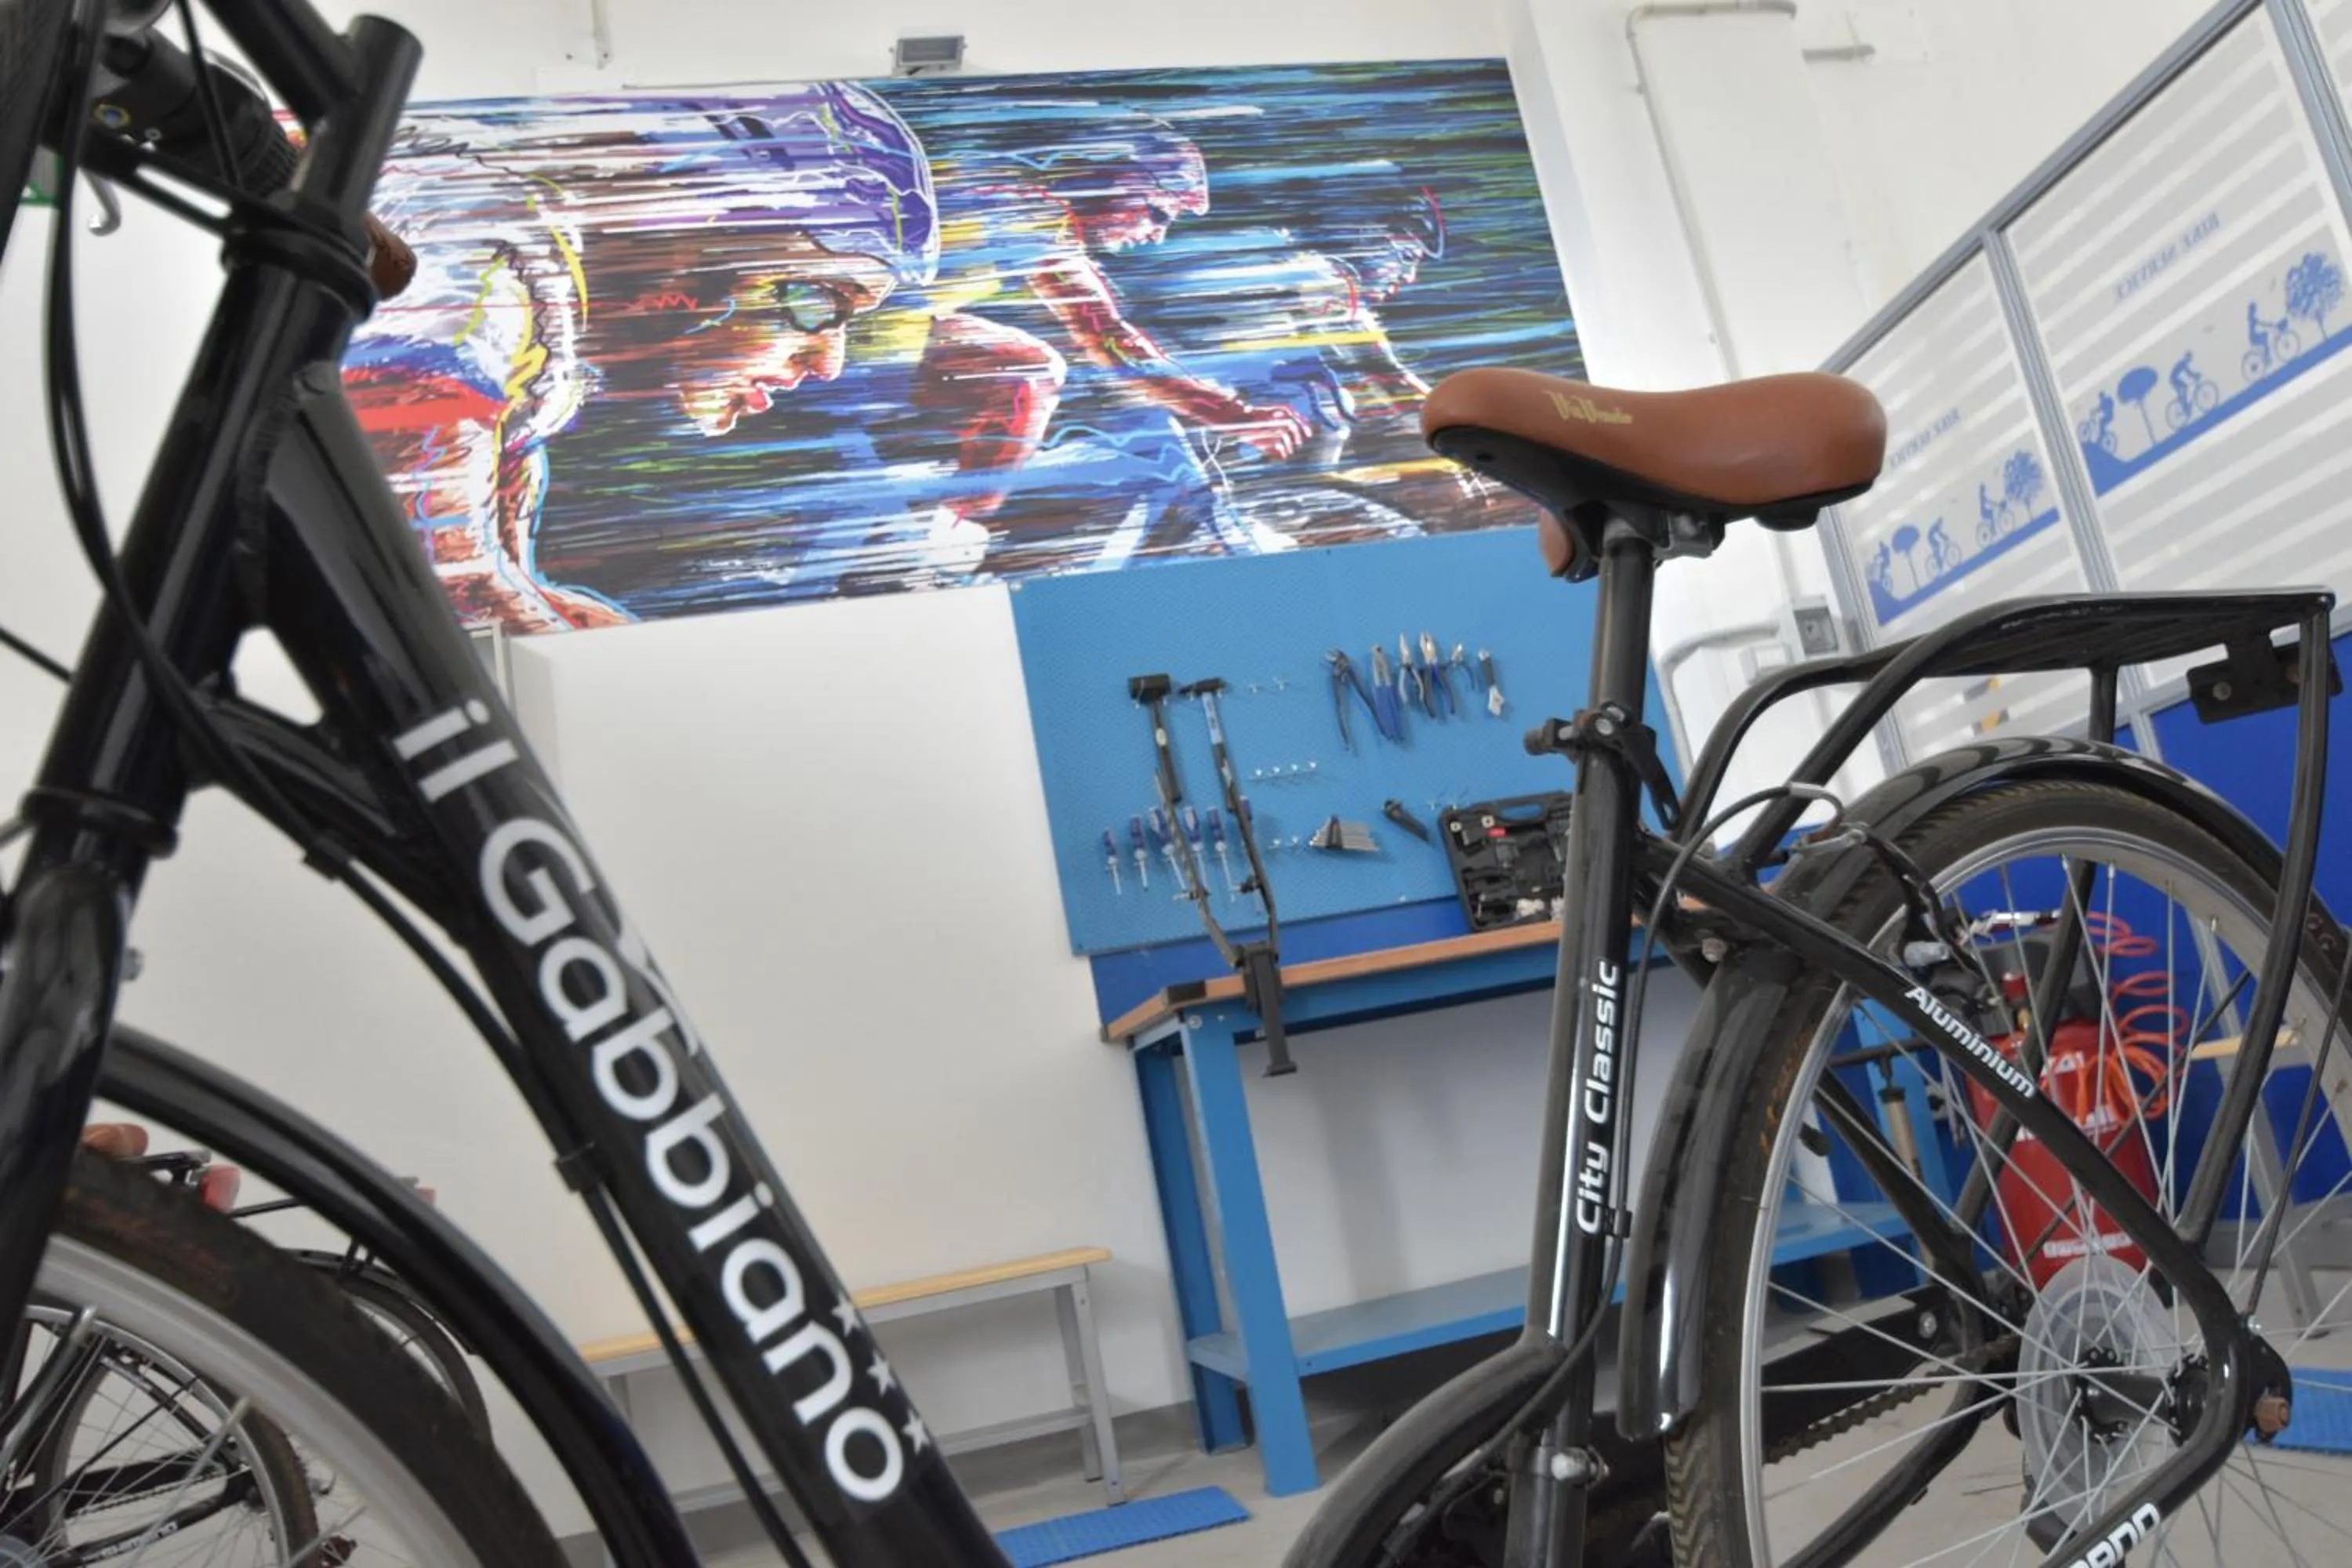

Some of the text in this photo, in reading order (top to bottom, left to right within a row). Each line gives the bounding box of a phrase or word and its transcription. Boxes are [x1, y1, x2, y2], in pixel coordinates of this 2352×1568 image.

[479, 817, 905, 1502] Gabbiano
[1575, 960, 1621, 1236] City Classic
[1904, 985, 2036, 1098] Aluminium
